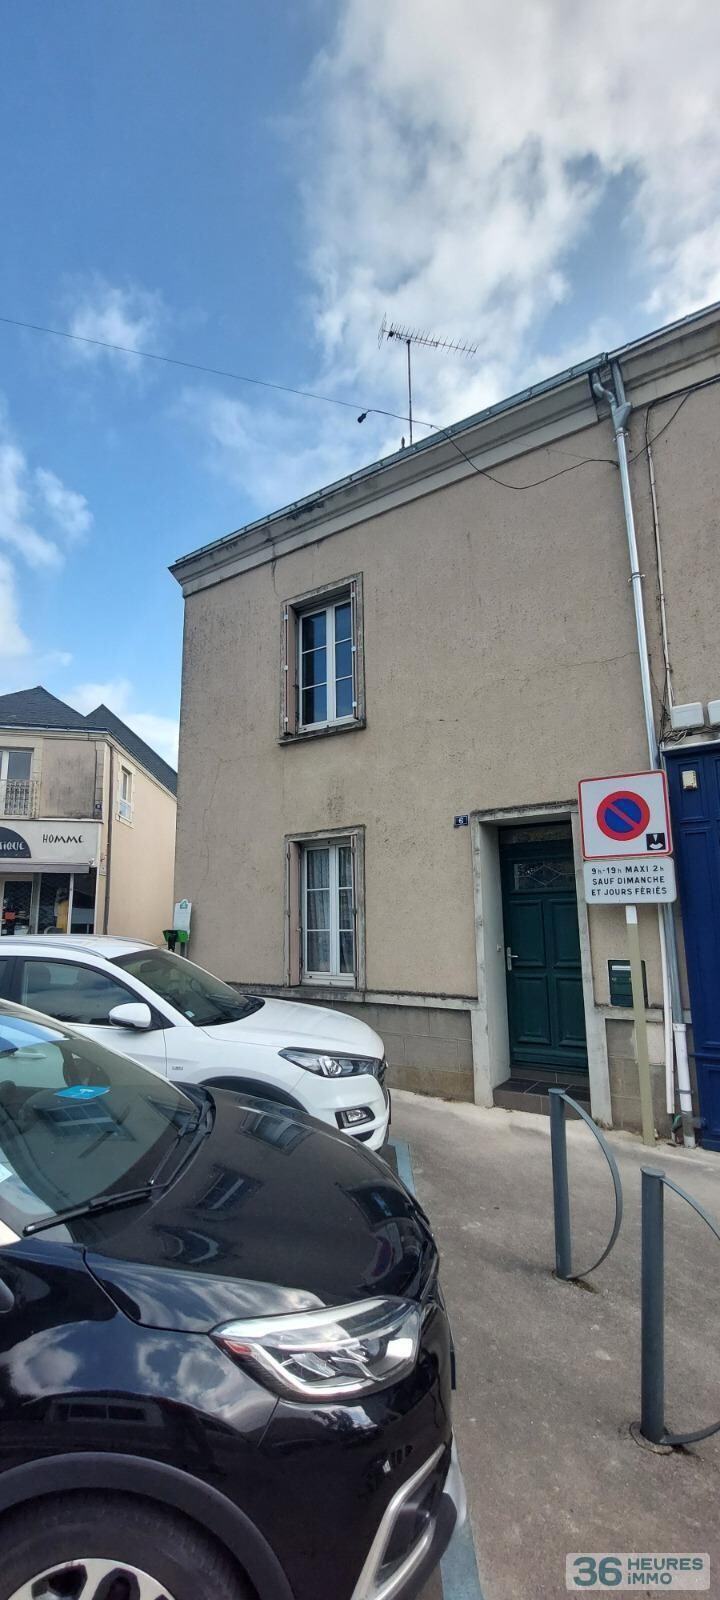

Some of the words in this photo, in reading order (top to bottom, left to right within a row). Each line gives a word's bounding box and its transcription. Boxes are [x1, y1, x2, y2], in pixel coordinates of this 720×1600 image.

[42, 833, 85, 844] HOMME
[625, 865, 649, 873] MAXI
[592, 877, 615, 885] SAUF
[617, 875, 665, 885] DIMANCHE
[604, 888, 633, 896] JOURS
